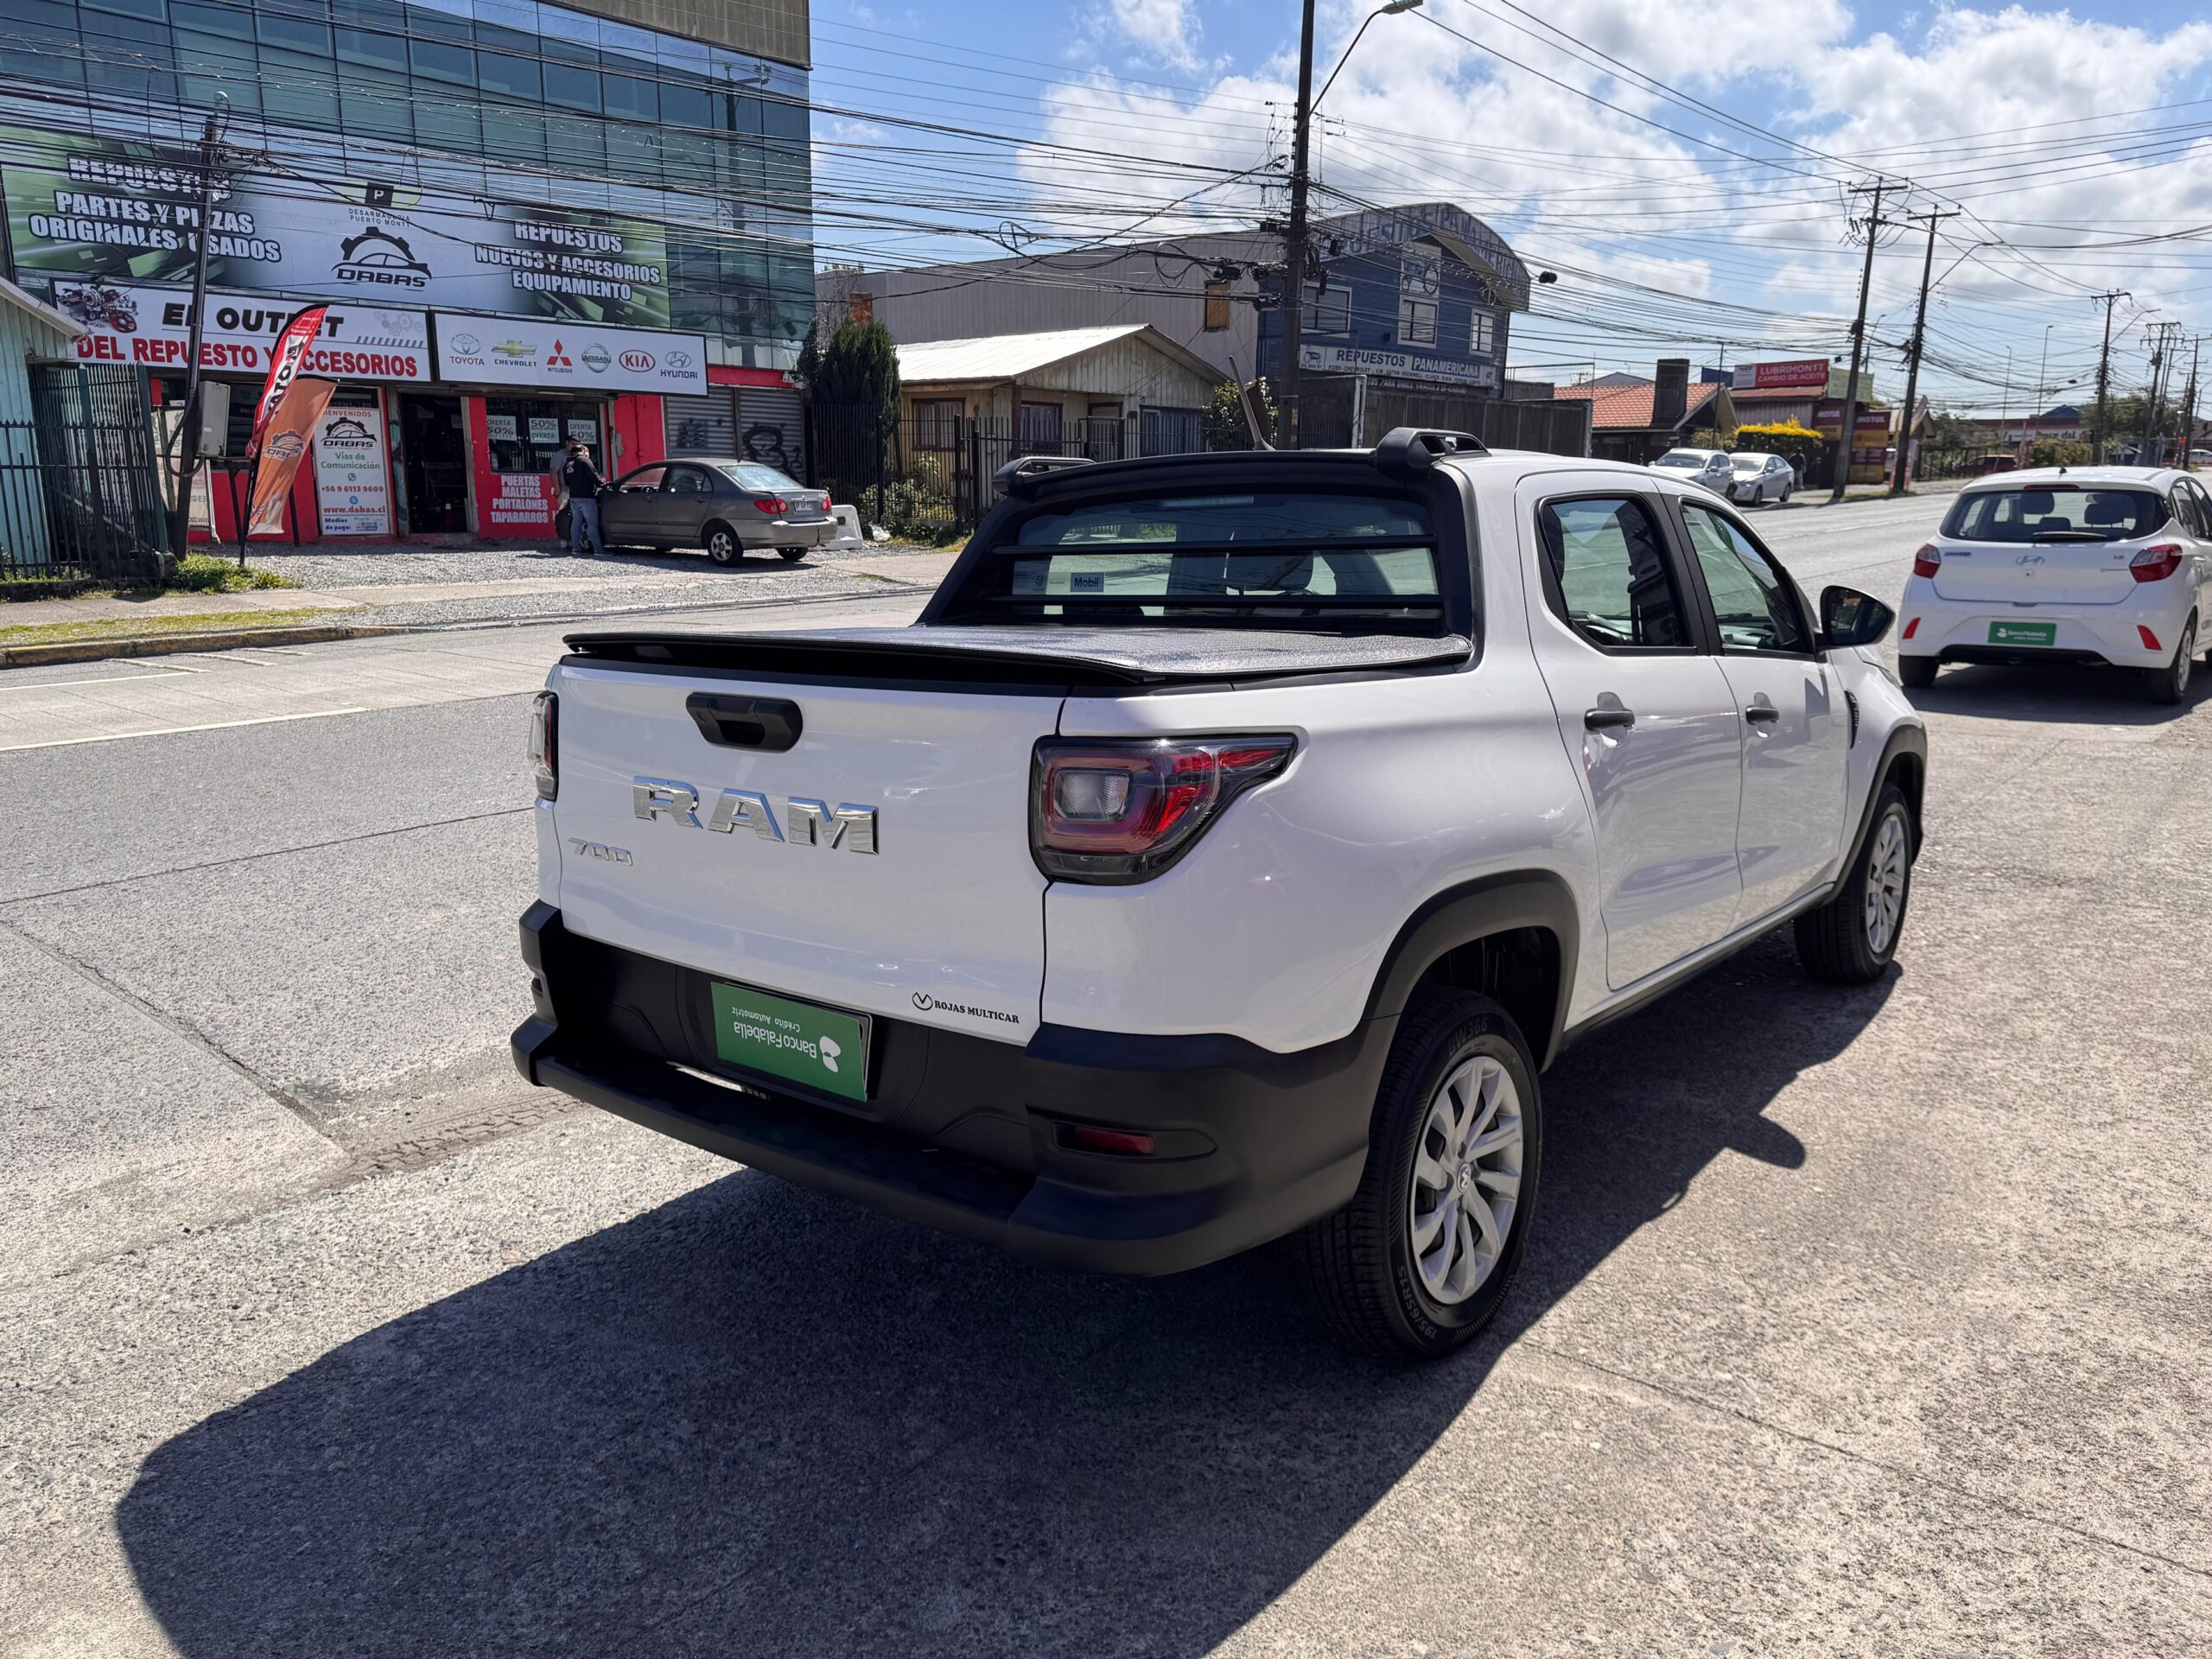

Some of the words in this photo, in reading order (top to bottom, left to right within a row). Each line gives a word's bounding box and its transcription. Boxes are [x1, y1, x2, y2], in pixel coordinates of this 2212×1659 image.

[374, 189, 385, 200] P
[55, 191, 150, 222] PARTES
[154, 203, 170, 224] Y
[175, 206, 254, 235] PIZAS
[350, 214, 382, 225] PUERTO
[385, 219, 410, 228] MONTT
[29, 214, 178, 251] ORIGINALES
[515, 222, 624, 254] REPUESTOS
[475, 245, 545, 270] NUEVOS
[547, 252, 558, 271] Y
[562, 256, 661, 284] ACCESORIOS
[336, 268, 426, 288] DABAS
[512, 270, 632, 301] EQUIPAMIENTO
[216, 306, 345, 337] OUTT
[77, 334, 125, 360] DEL
[299, 347, 418, 378] CCESORIOS
[449, 355, 486, 366] TOYOTA
[494, 359, 537, 367] CHEVROLET
[626, 354, 650, 368] KIA
[1336, 349, 1406, 367] REPUESTOS
[1413, 357, 1479, 378] PANAMERICANA
[1759, 364, 1825, 375] LUBRIMONTT
[660, 369, 698, 380] HYUNDAI
[1799, 372, 1826, 380] ACEITE
[487, 427, 514, 435] 50%
[531, 419, 556, 429] 50%
[321, 461, 381, 470] Comunicación
[501, 475, 541, 486] PUERTAS
[501, 486, 542, 499] MALETAS
[492, 498, 549, 511] PORTALONES
[490, 512, 549, 524] TAPABARROS
[1074, 576, 1099, 588] Mobil
[632, 774, 880, 855] RAM
[566, 836, 633, 867] 700
[732, 1007, 771, 1025] Automotriz
[934, 1000, 966, 1014] ROJAS
[967, 1007, 1020, 1024] MULTICAR
[774, 1018, 800, 1033] Crédito
[1396, 1266, 1438, 1339] 195/65R15
